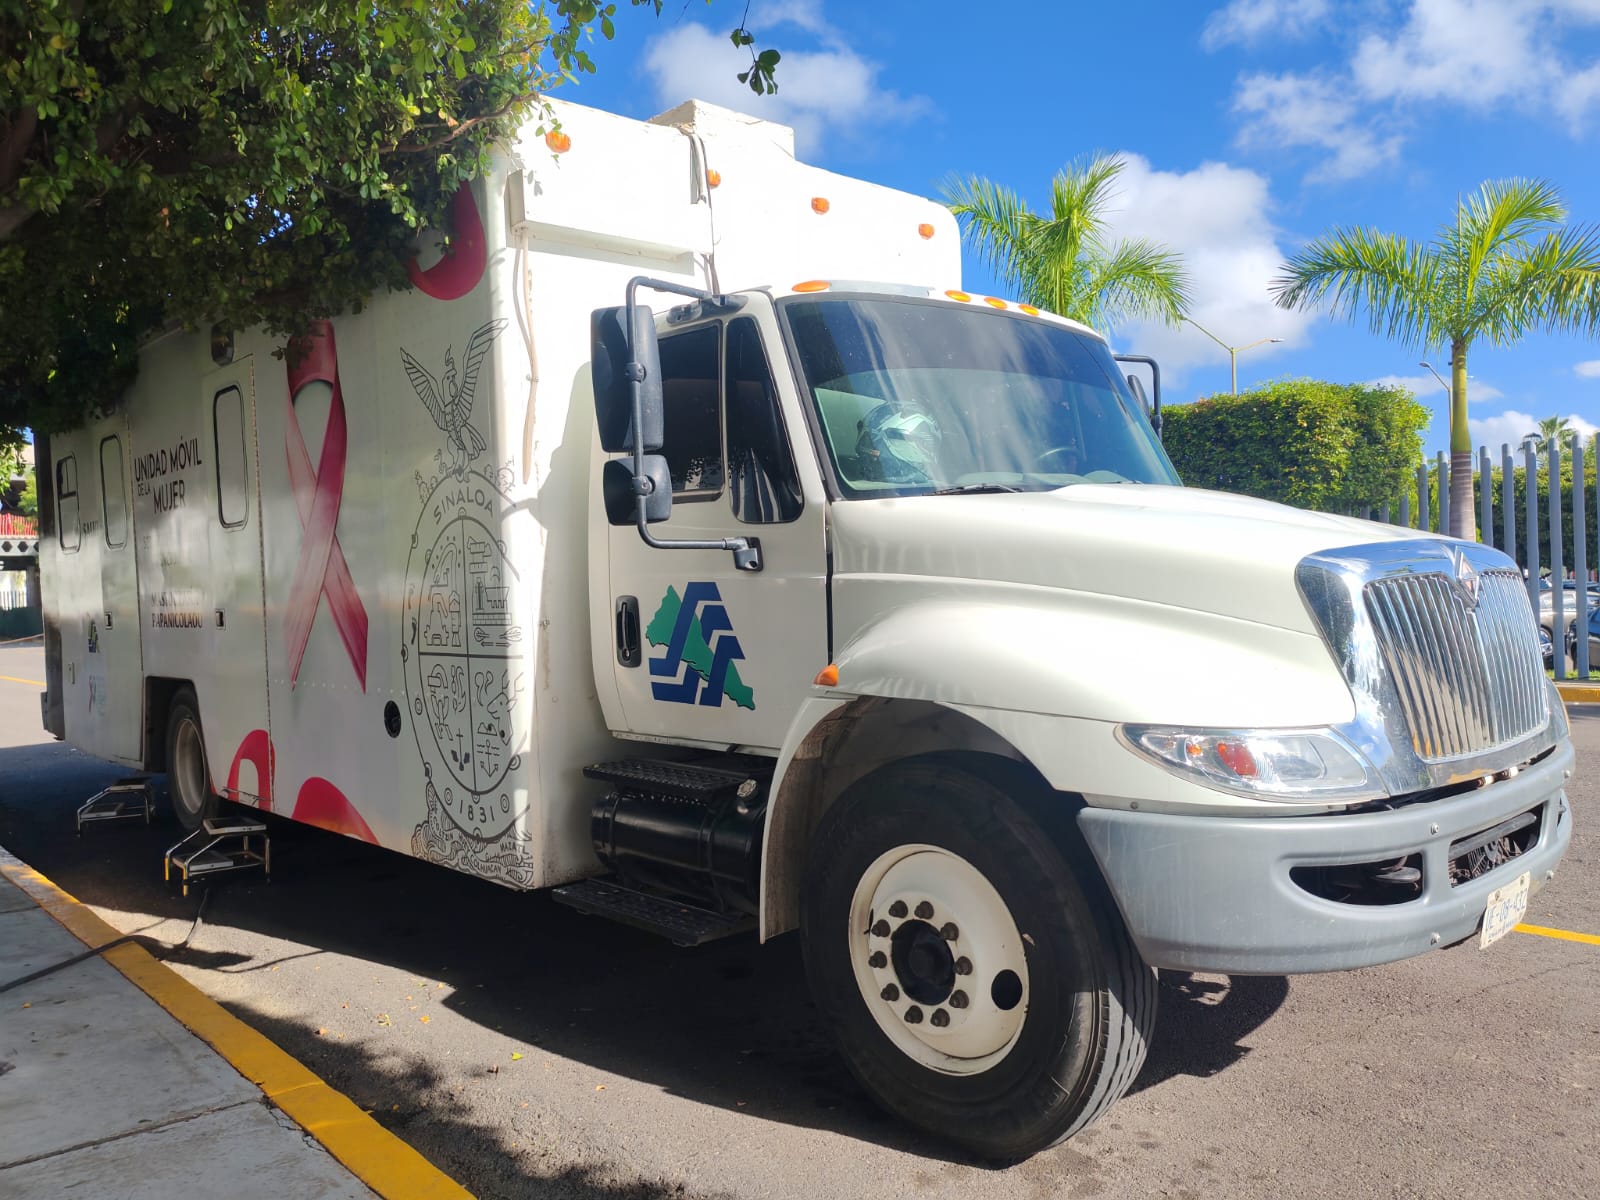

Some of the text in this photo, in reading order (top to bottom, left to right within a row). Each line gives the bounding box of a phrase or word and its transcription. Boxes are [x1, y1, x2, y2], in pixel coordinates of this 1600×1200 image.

[134, 434, 202, 482] UNIDAD MÓVIL
[153, 479, 186, 514] MUJER
[433, 486, 493, 525] SINALOA
[459, 799, 495, 824] 1831
